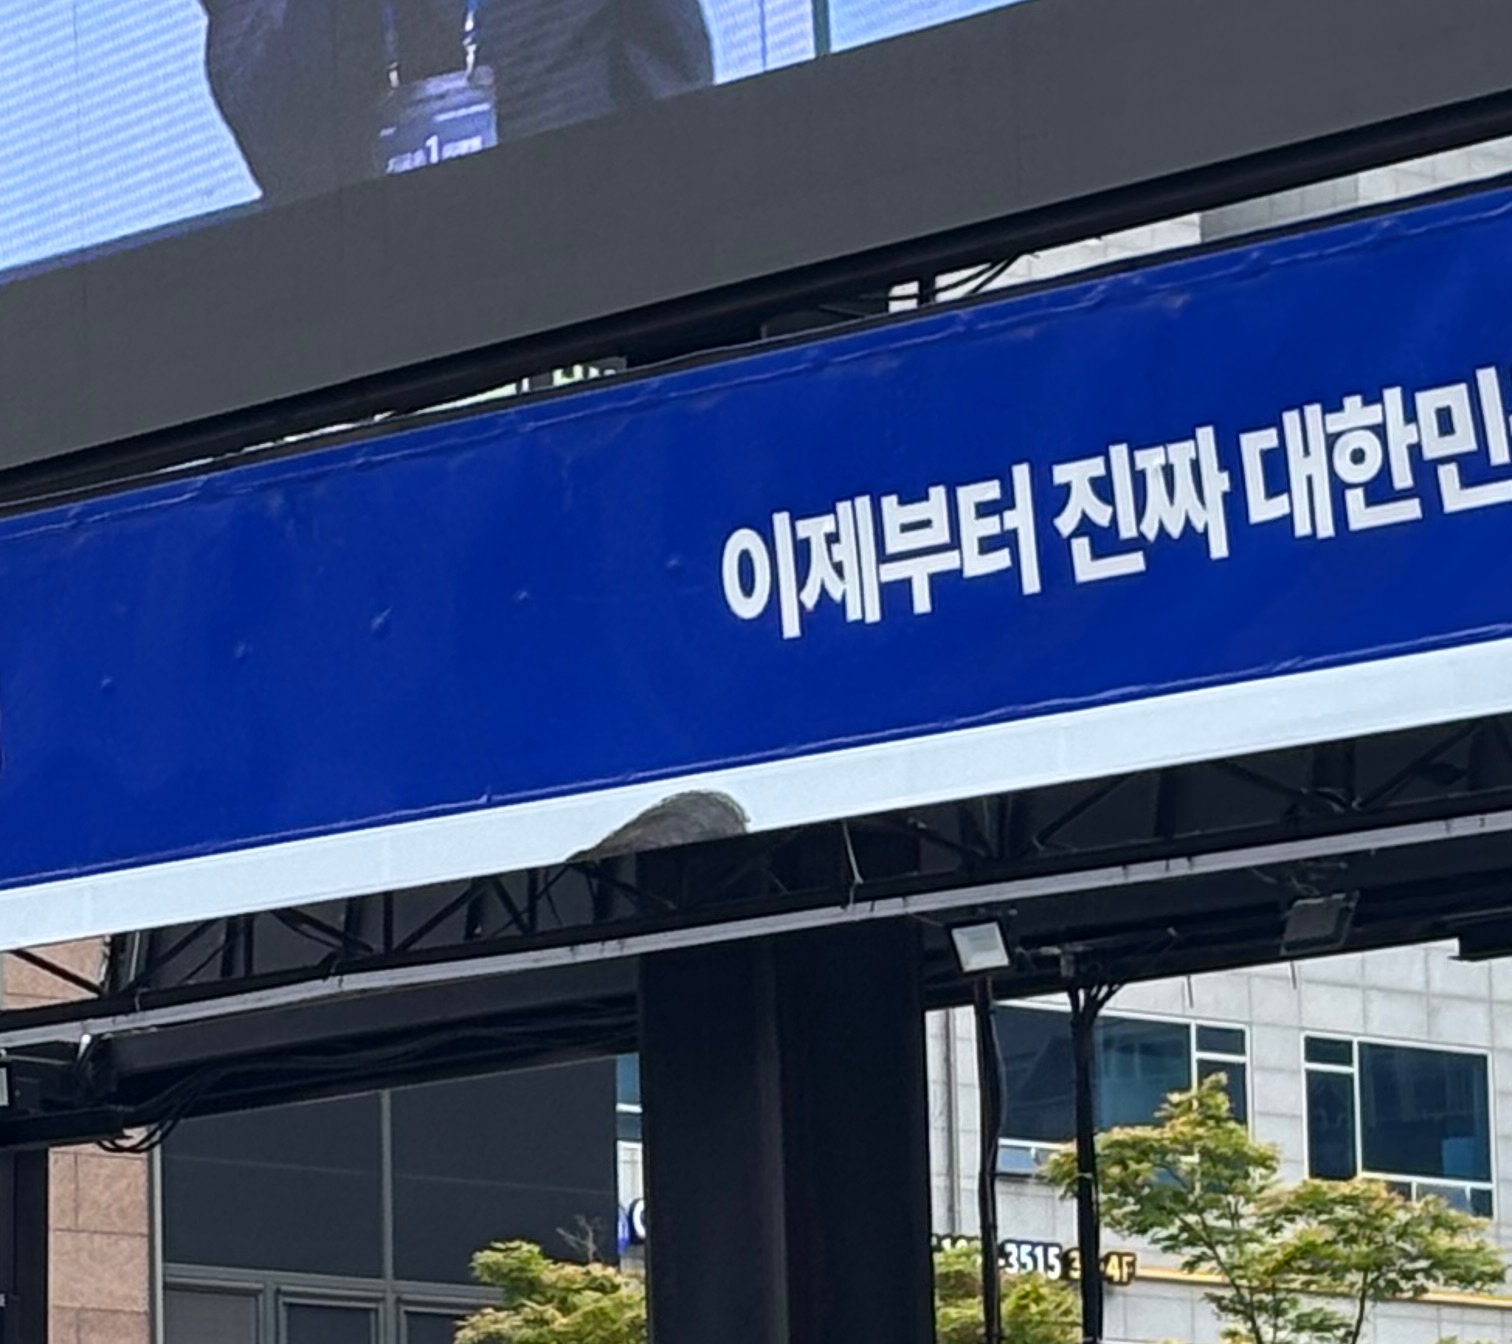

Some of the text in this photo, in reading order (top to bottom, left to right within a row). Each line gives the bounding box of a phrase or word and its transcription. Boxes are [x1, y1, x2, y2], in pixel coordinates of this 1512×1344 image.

[721, 366, 1512, 640] 이제부터 진짜 대한민
